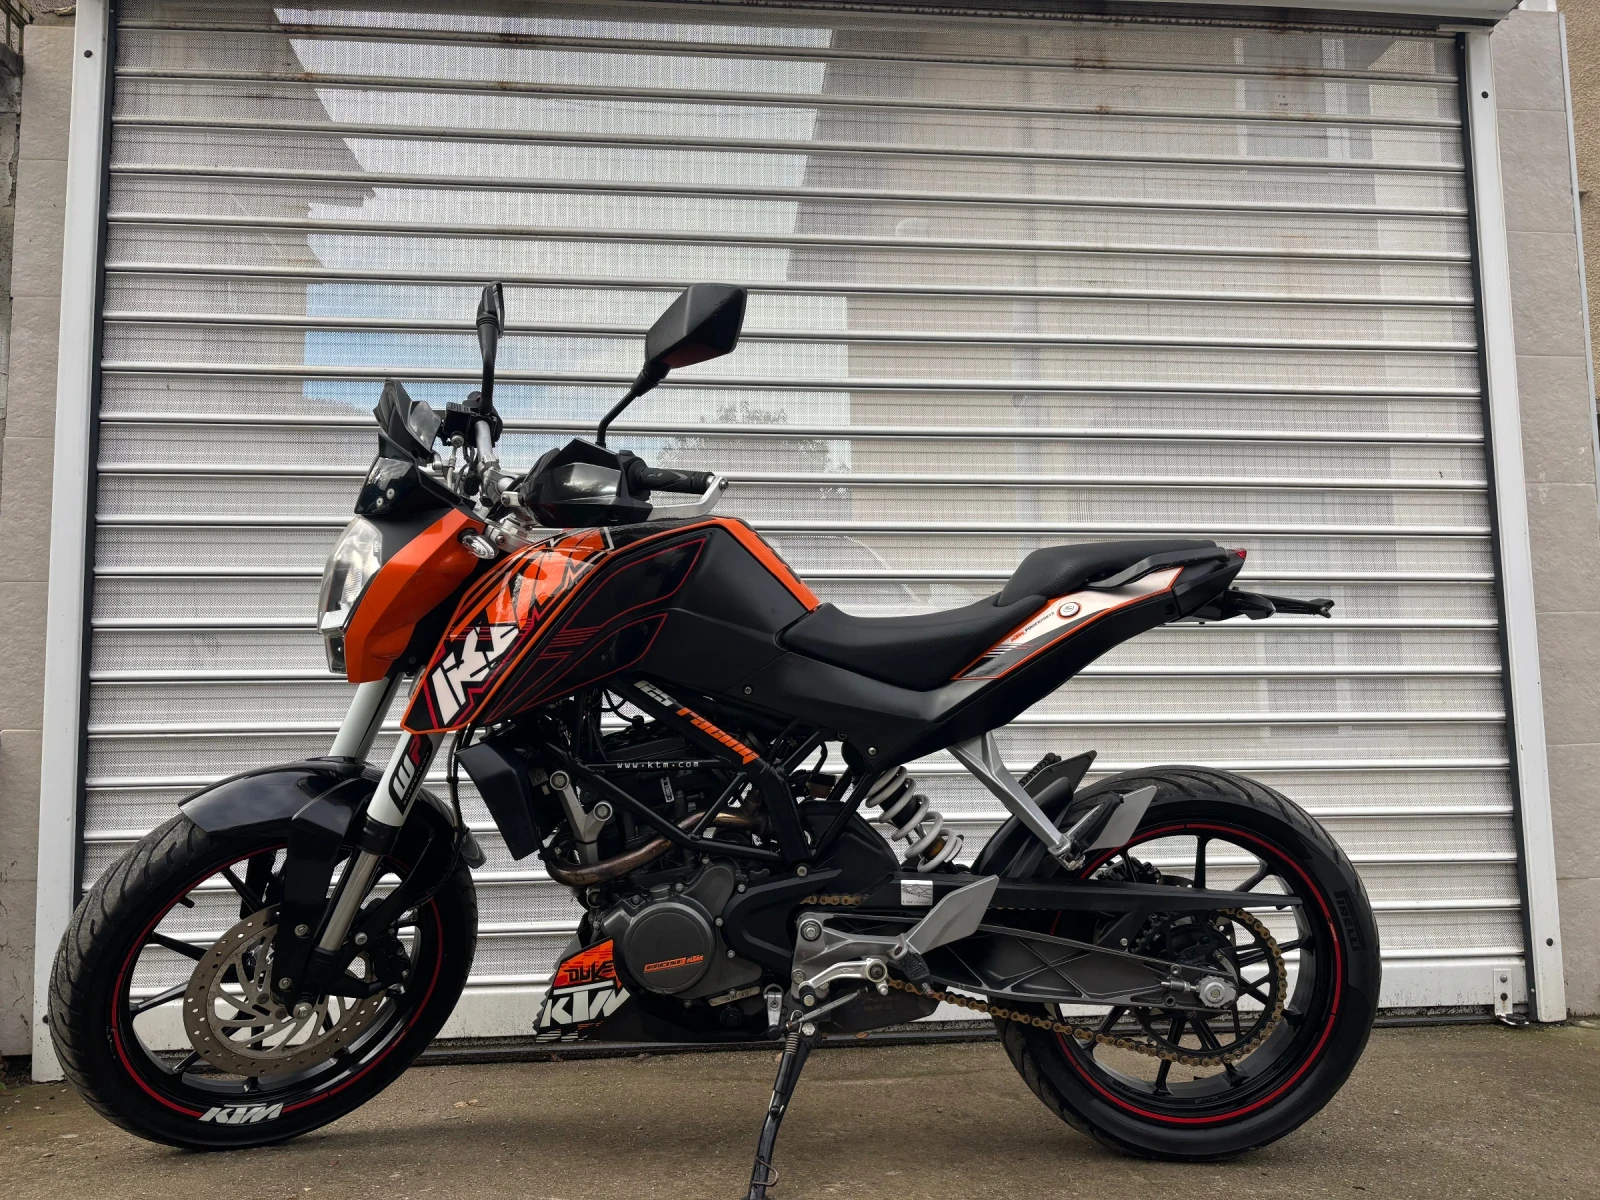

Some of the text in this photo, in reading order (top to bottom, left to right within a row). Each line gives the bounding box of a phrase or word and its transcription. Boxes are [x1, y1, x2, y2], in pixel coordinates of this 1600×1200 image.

[676, 707, 759, 765] racing
[616, 761, 699, 769] www.ktm.com
[1333, 889, 1367, 952] PIRELLI
[563, 960, 616, 982] DUKE
[540, 980, 631, 1028] KTM
[198, 1102, 284, 1124] KTM
